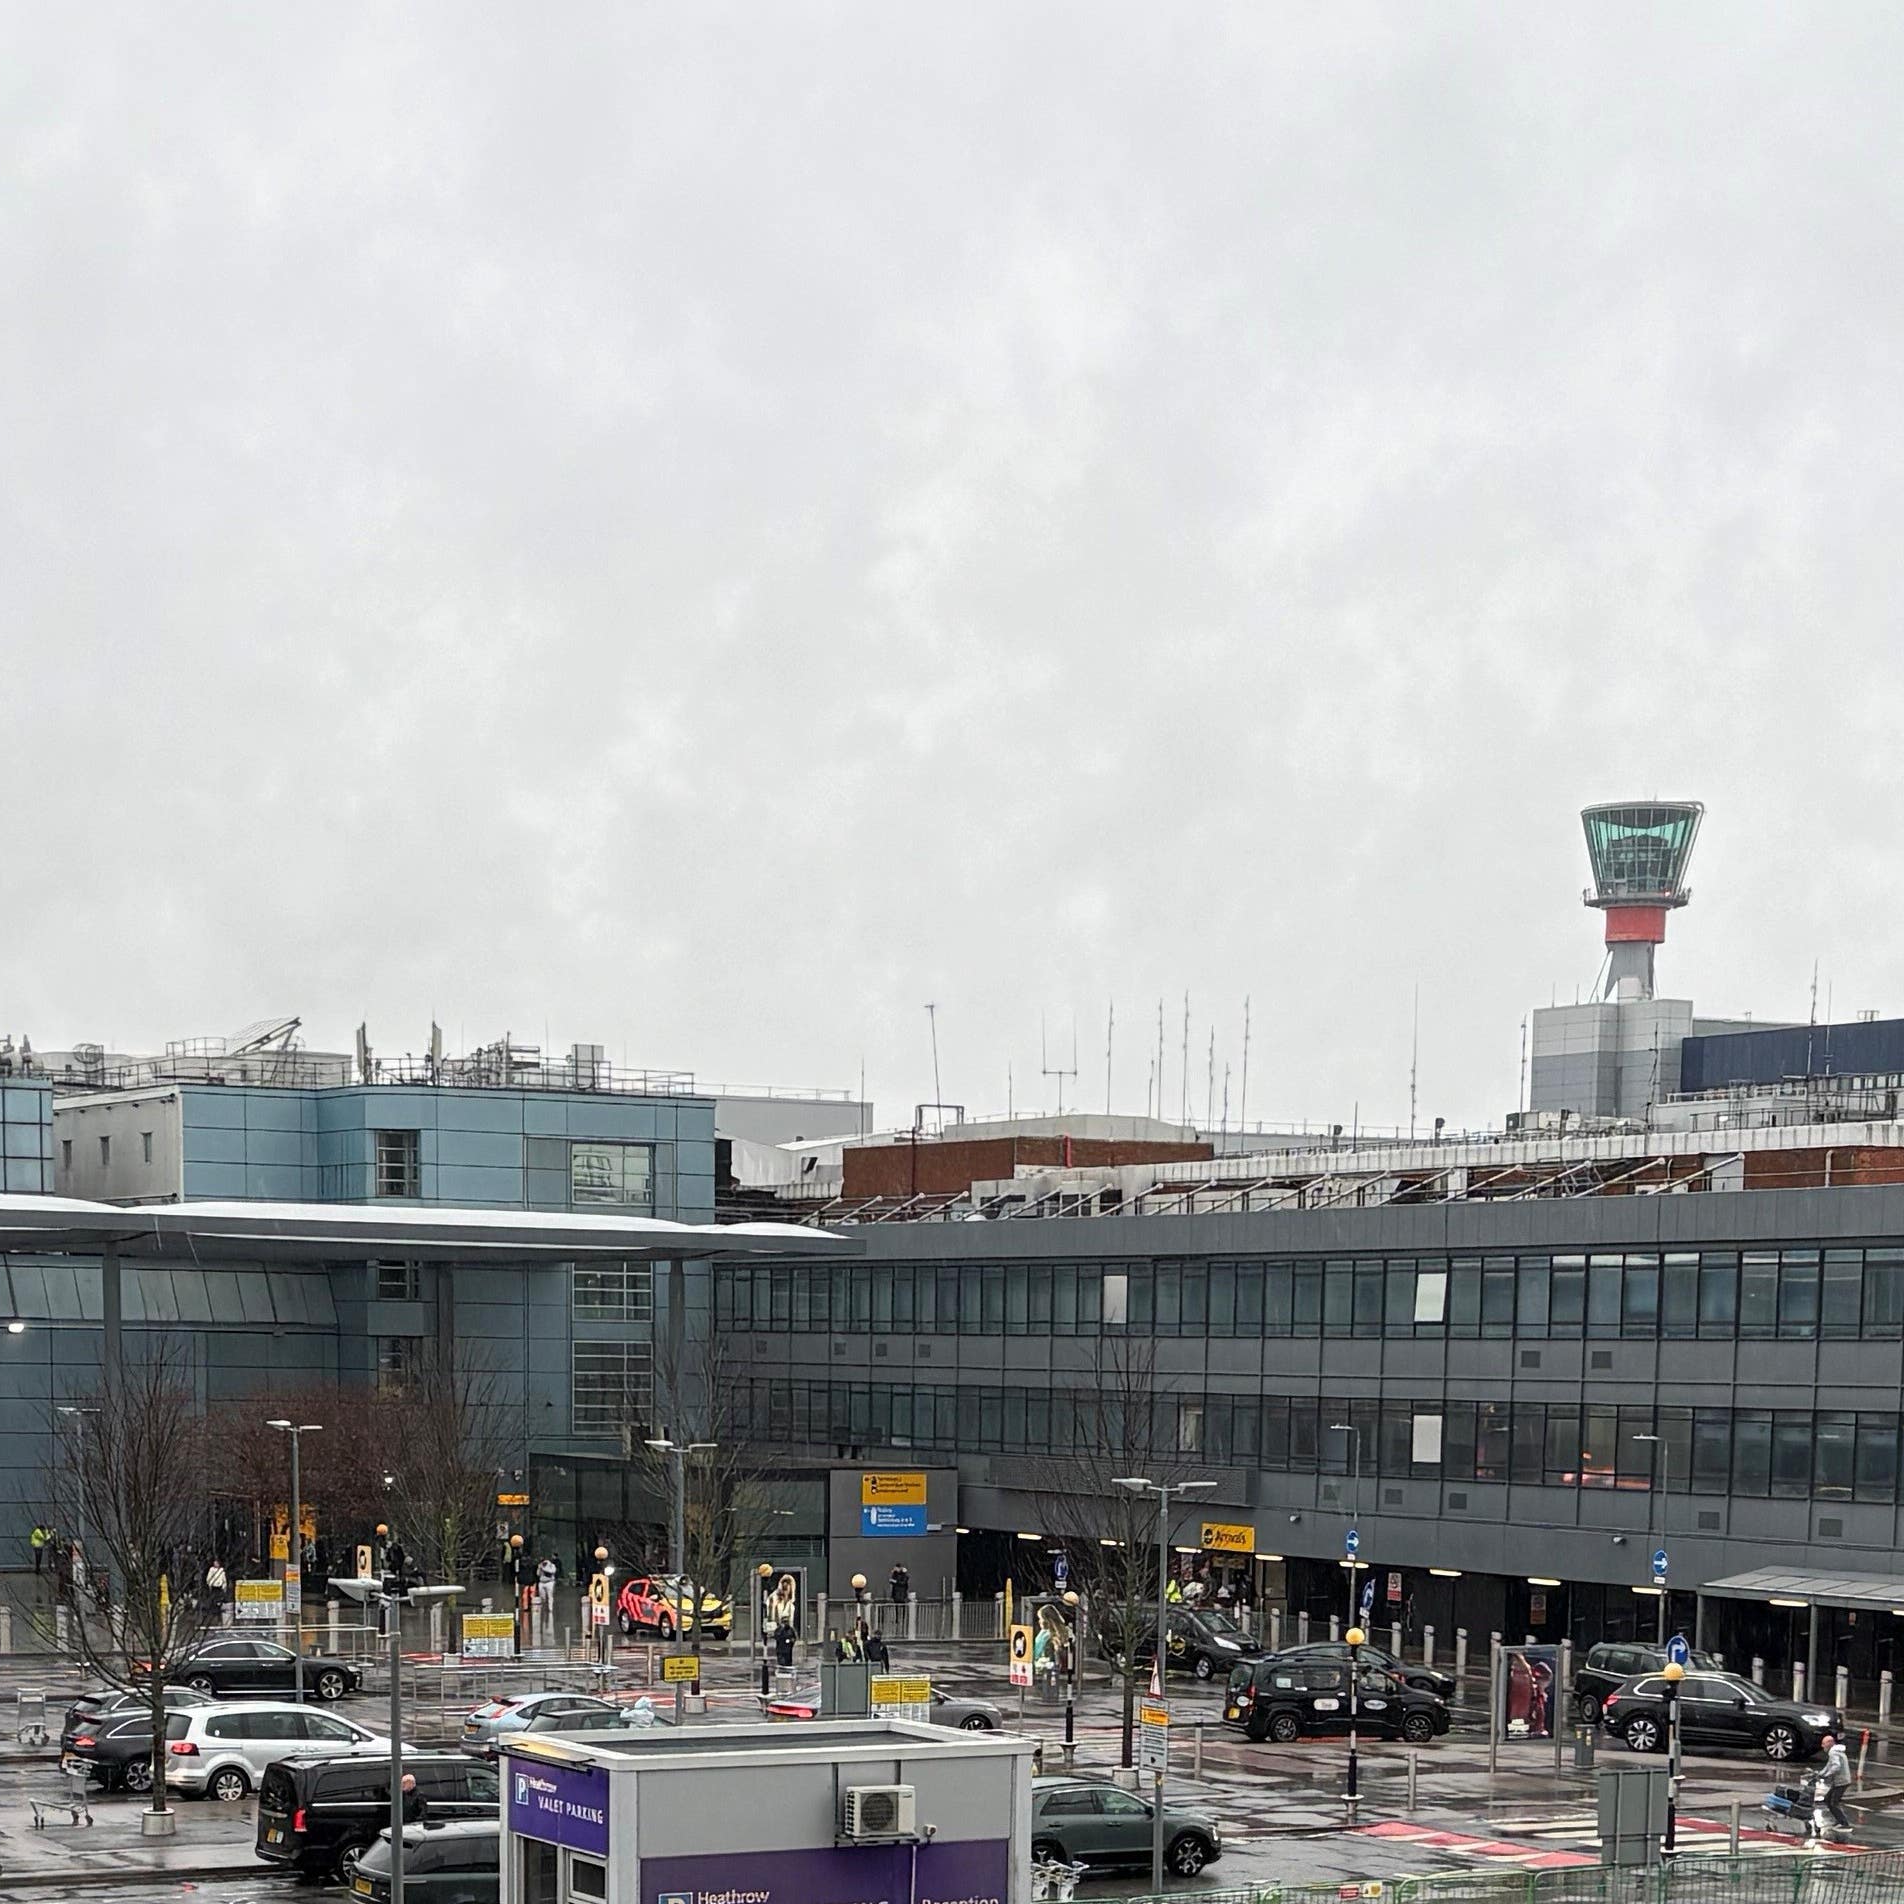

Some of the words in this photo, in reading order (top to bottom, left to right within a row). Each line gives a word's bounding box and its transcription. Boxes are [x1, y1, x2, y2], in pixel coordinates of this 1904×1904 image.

[518, 1778, 526, 1801] P
[538, 1796, 564, 1815] VALET
[566, 1803, 603, 1825] PARKING
